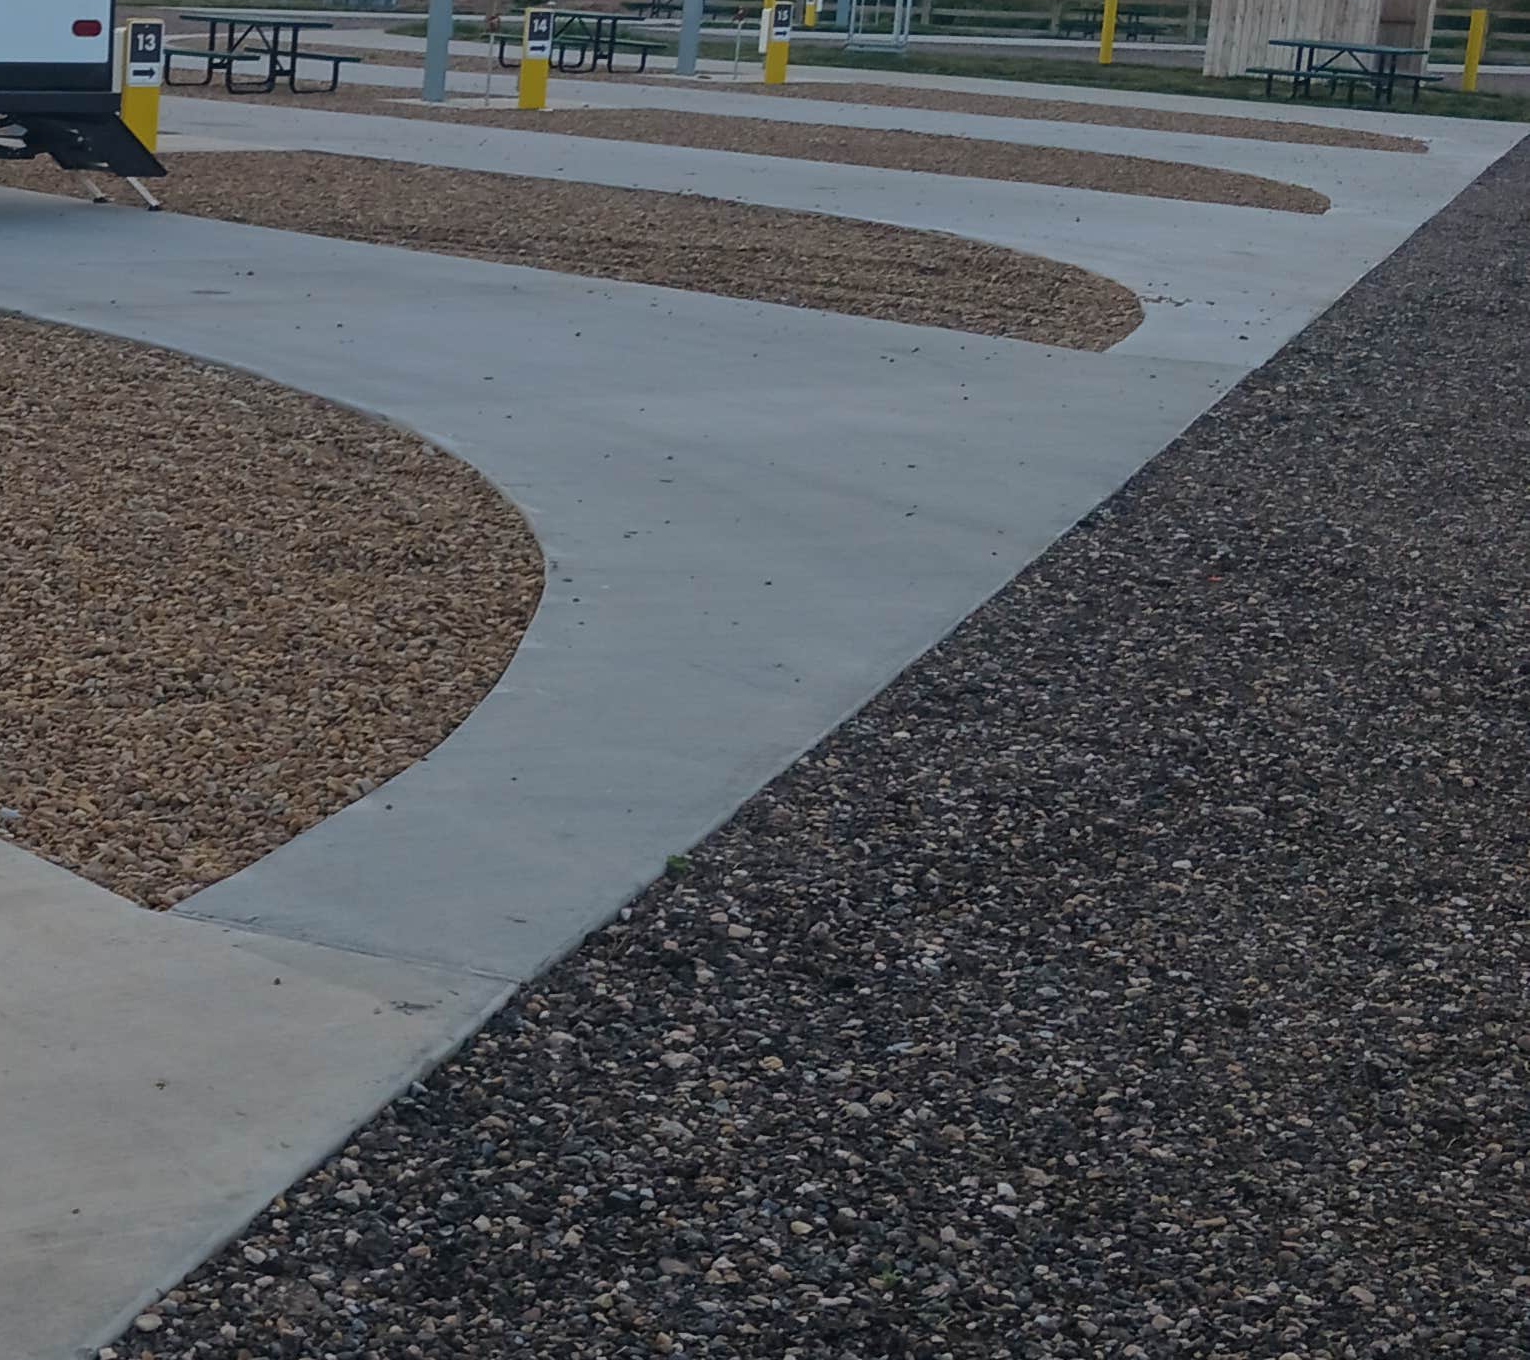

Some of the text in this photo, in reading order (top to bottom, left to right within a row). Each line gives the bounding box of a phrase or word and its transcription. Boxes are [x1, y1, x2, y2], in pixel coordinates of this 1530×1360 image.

[777, 8, 790, 21] 15
[533, 18, 548, 33] 14
[136, 33, 157, 52] 13
